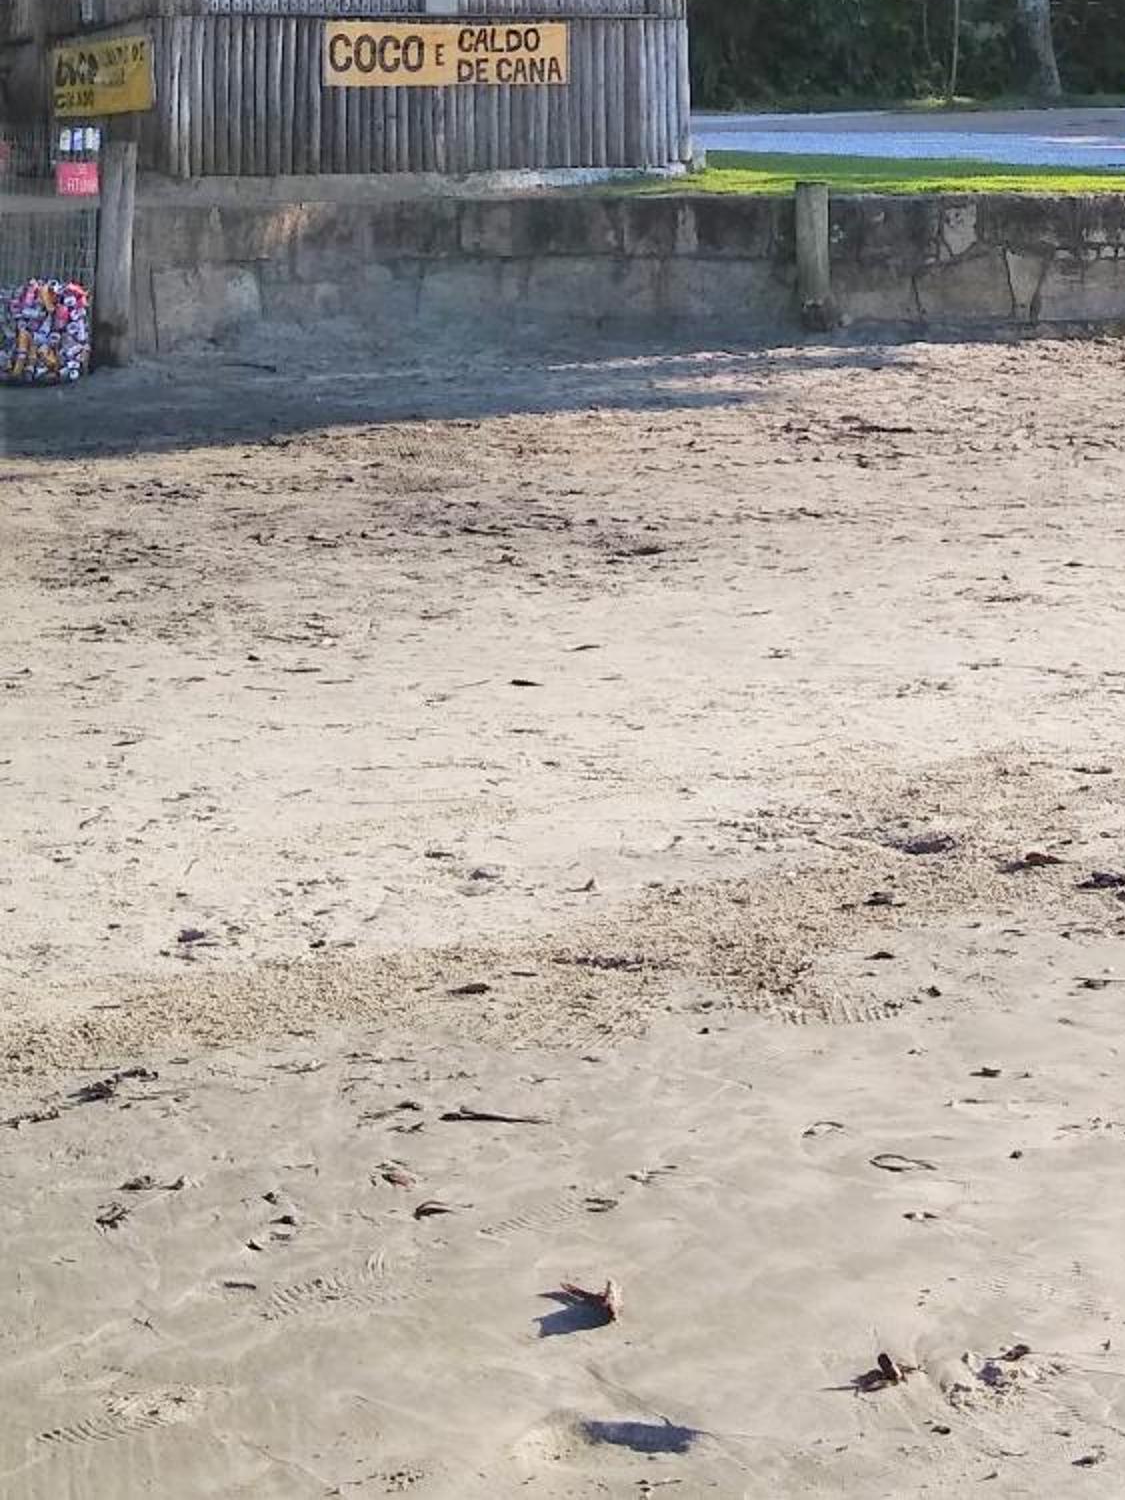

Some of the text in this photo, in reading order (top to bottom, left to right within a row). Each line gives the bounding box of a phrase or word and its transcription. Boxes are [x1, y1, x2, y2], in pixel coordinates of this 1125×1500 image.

[329, 33, 445, 73] COCO E
[457, 27, 541, 53] CALDO
[457, 56, 562, 83] DE CANA
